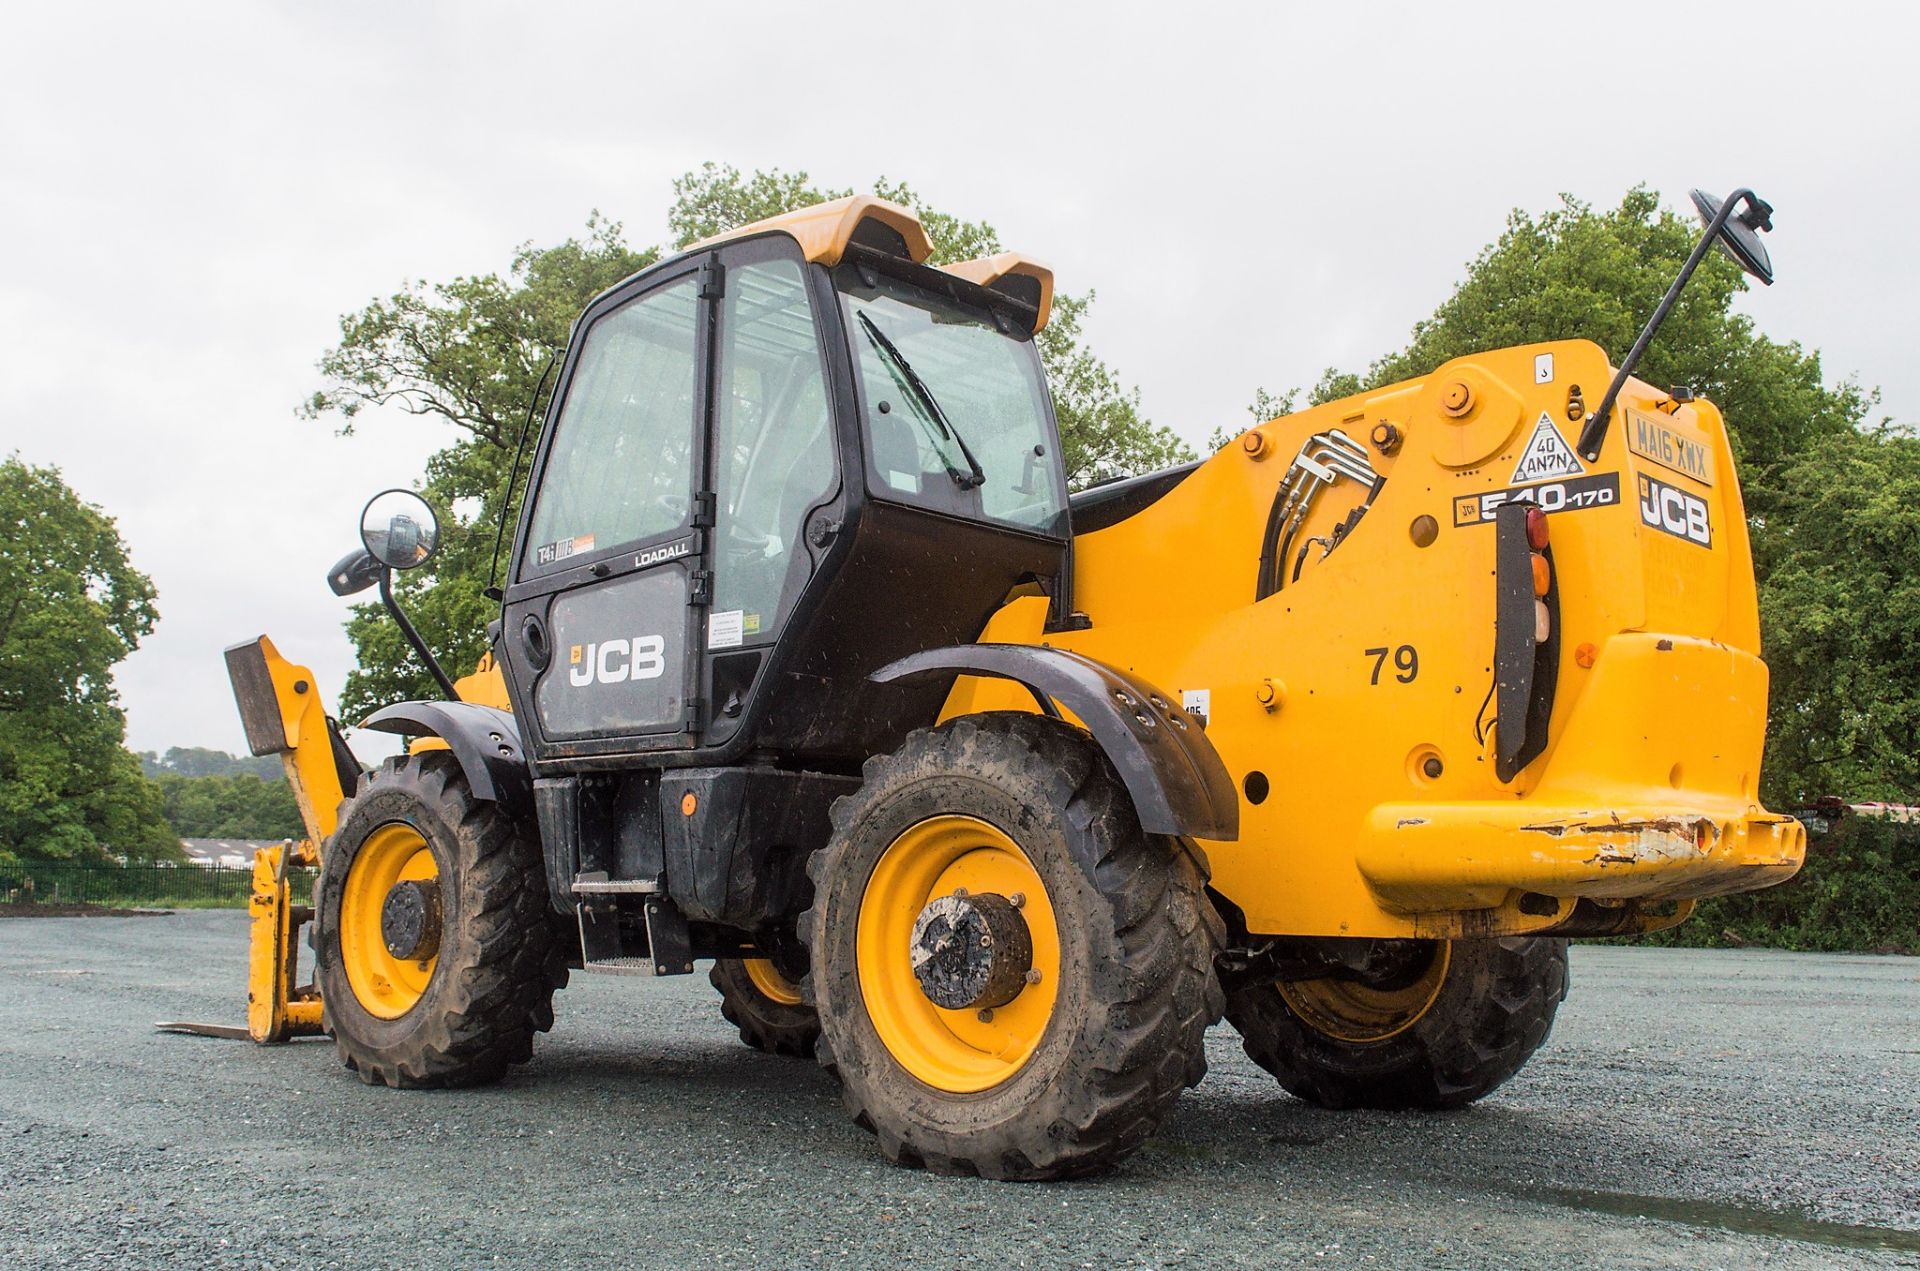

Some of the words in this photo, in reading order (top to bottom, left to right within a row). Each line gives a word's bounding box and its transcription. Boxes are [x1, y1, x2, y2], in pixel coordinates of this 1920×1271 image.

[1527, 453, 1567, 473] AN7N
[1636, 418, 1673, 463] MA16
[1675, 436, 1707, 478] XWX
[1640, 481, 1710, 544] JCB
[538, 545, 555, 563] T4i
[635, 543, 689, 567] LOADALL
[569, 635, 665, 687] JCB
[1365, 644, 1418, 686] 79
